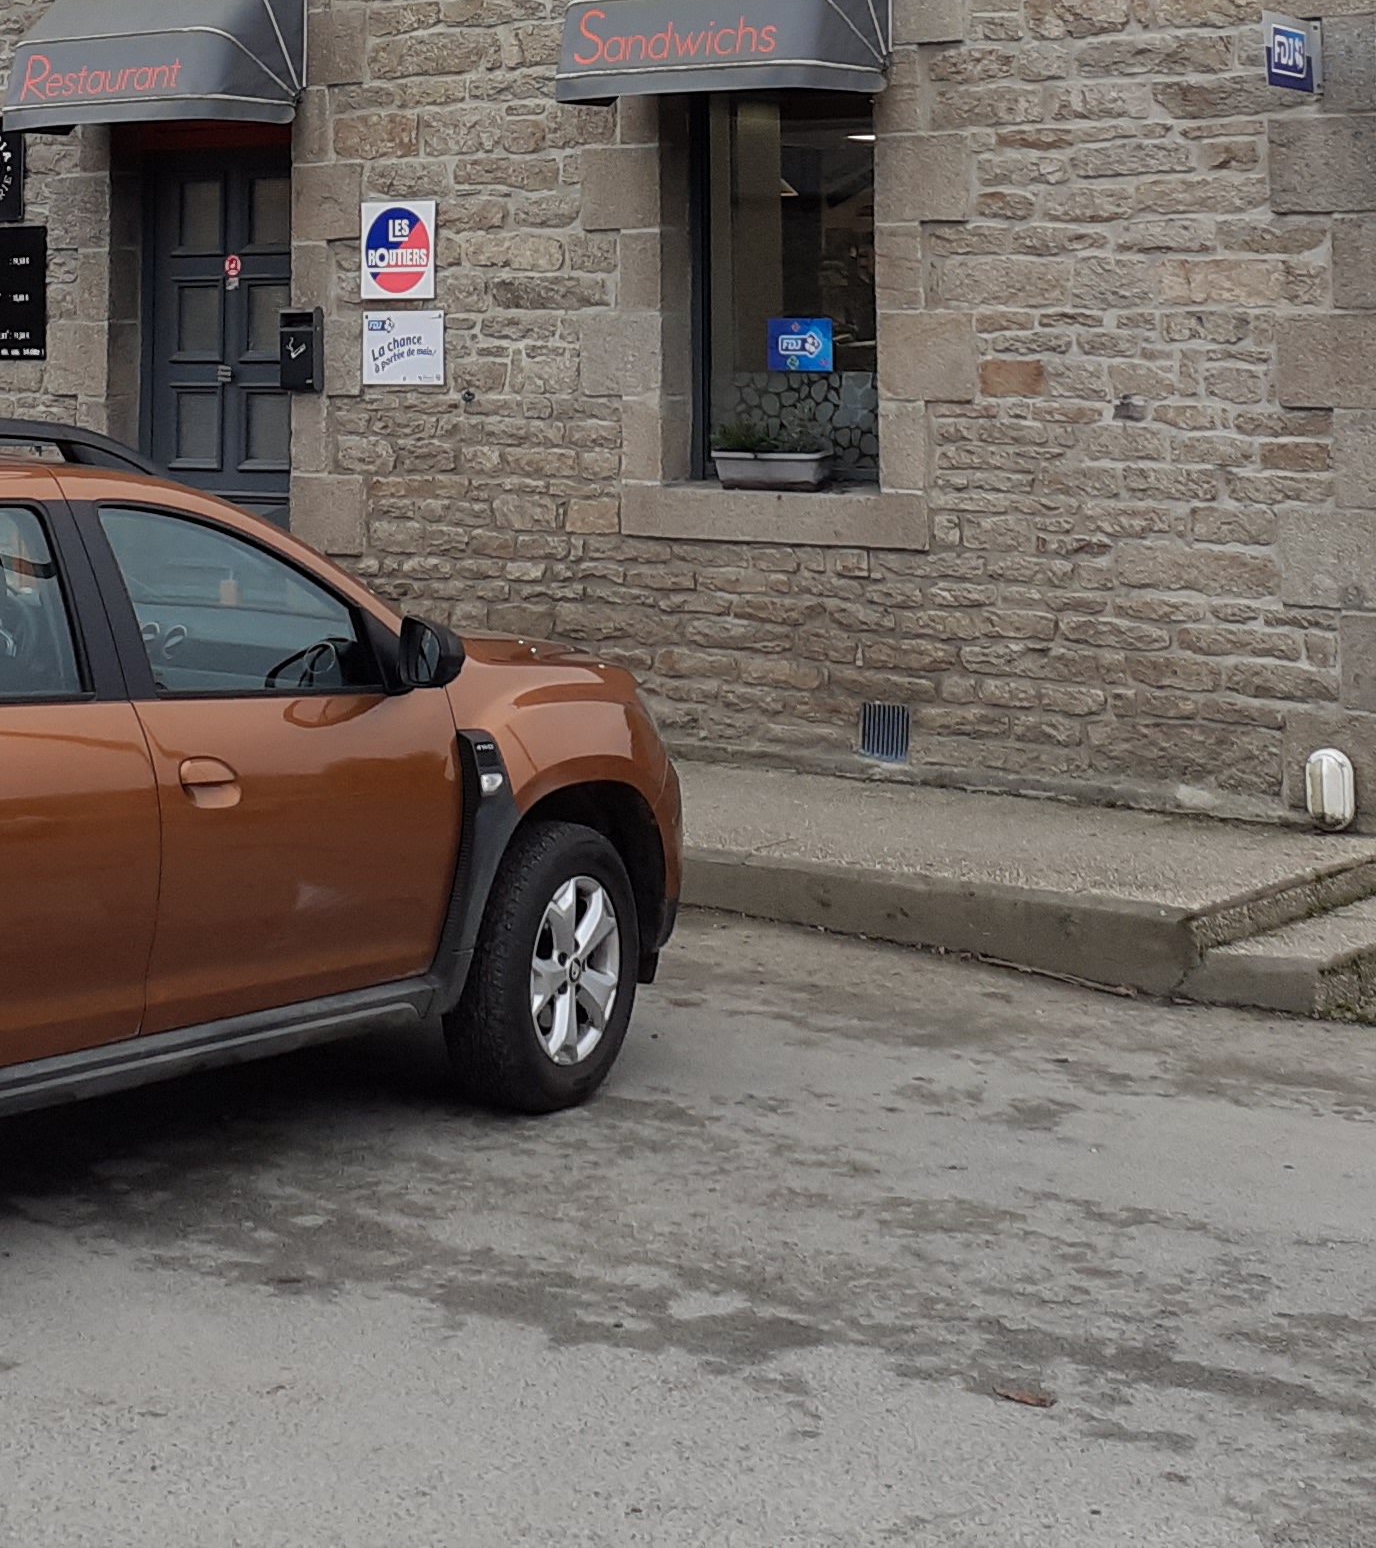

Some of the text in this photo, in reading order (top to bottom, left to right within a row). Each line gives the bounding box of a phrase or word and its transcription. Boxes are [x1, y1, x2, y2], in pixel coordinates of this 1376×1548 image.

[574, 9, 777, 64] Sandwichs
[1274, 35, 1294, 66] FDJ
[20, 54, 181, 101] Restaurant
[389, 219, 410, 241] LES
[368, 248, 427, 267] ROUTIERS
[371, 336, 422, 362] La chance
[406, 348, 415, 357] de
[782, 339, 802, 350] FDJ
